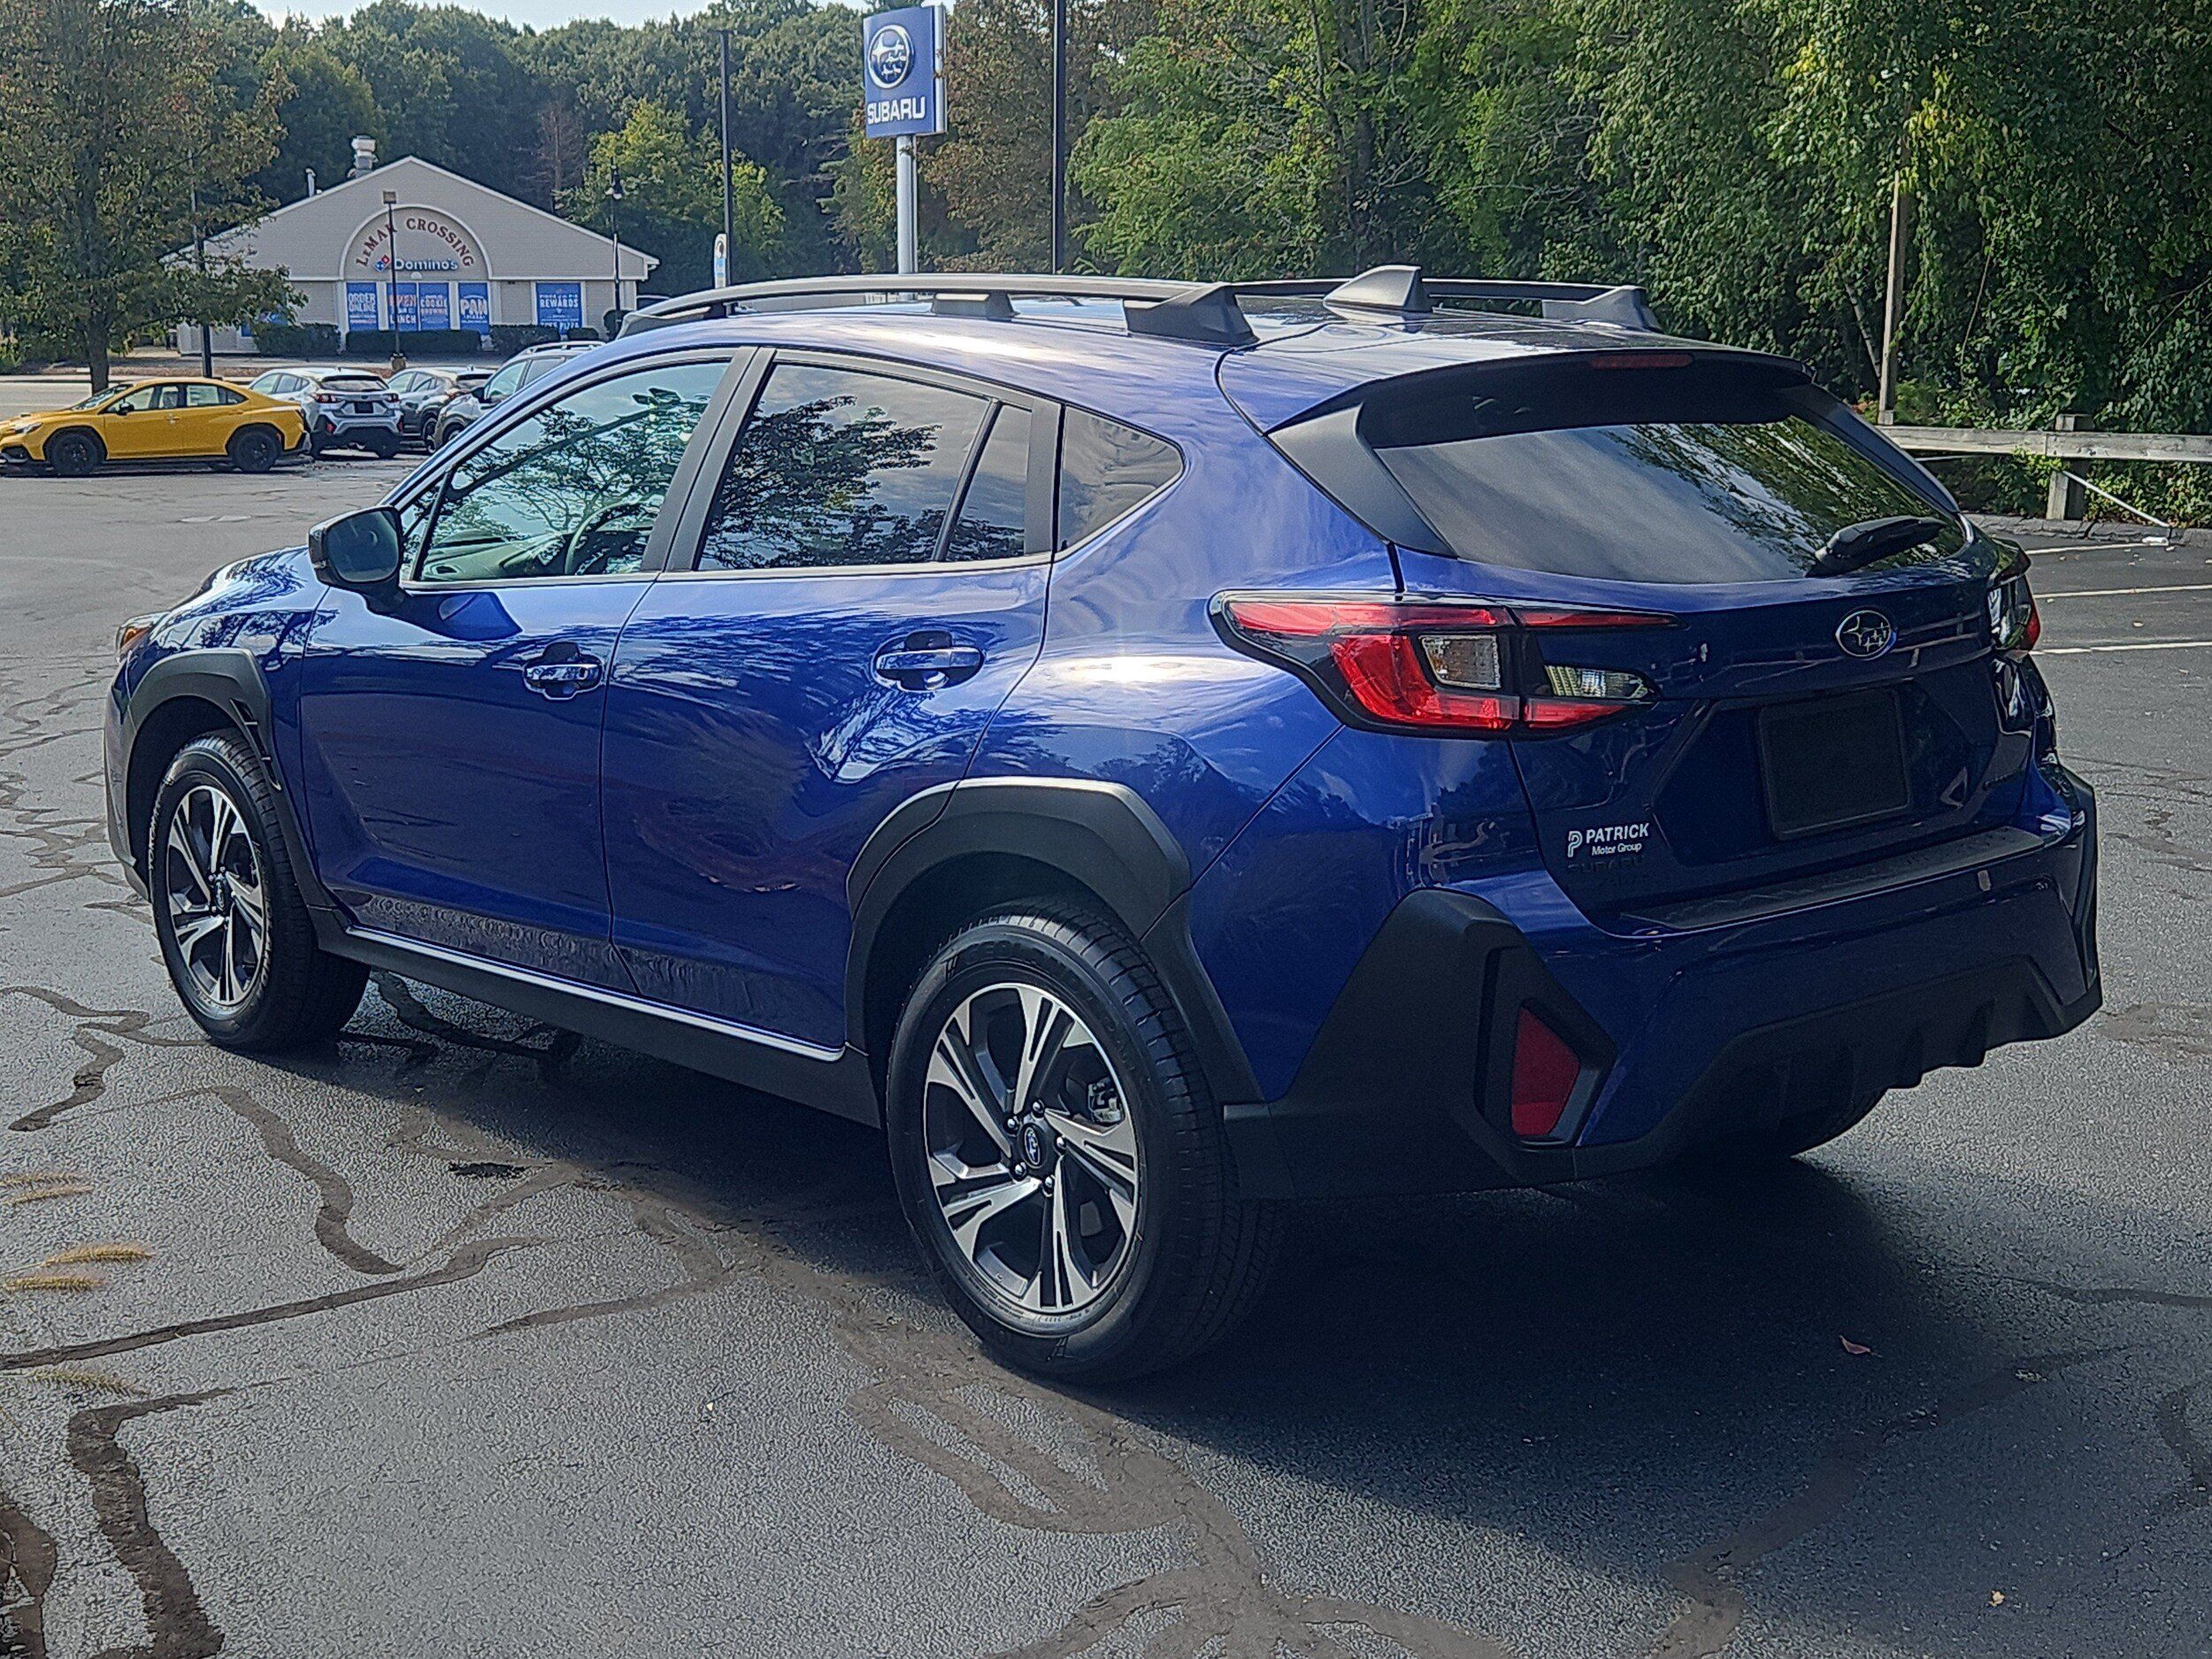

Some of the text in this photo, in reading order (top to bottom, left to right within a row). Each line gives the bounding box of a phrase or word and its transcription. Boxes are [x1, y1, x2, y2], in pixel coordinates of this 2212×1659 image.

[867, 96, 926, 125] SUBARU
[406, 218, 474, 266] CROSSING
[394, 257, 458, 271] Domino's
[348, 293, 376, 303] ORDER
[540, 298, 579, 308] REWARDS
[349, 302, 377, 312] ONLINE
[460, 299, 488, 315] PAN
[1586, 822, 1650, 844] PATRICK
[1592, 842, 1642, 856] Motor Group
